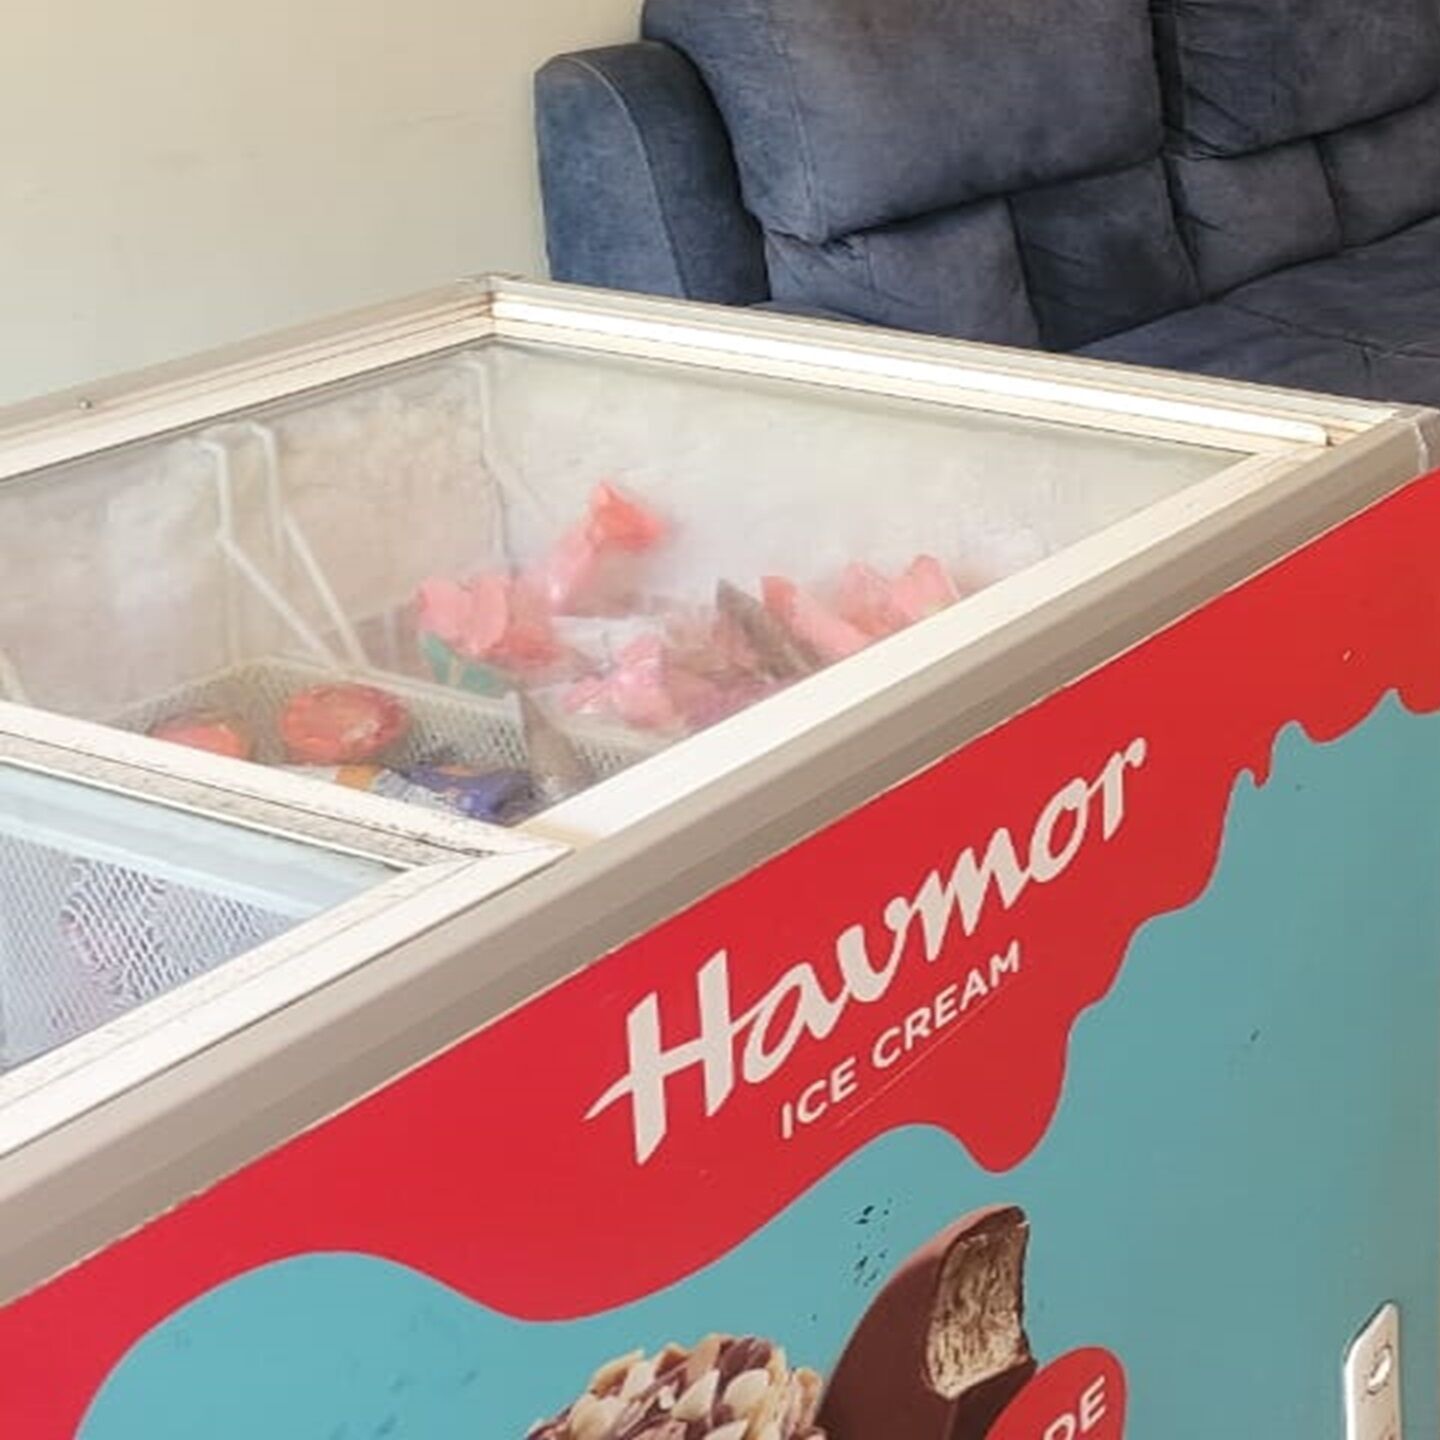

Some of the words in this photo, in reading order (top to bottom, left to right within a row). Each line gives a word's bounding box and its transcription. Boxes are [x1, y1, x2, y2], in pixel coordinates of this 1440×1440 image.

[583, 737, 1147, 1166] Havmor
[780, 1058, 856, 1138] ICE
[873, 940, 1020, 1070] CREAM
